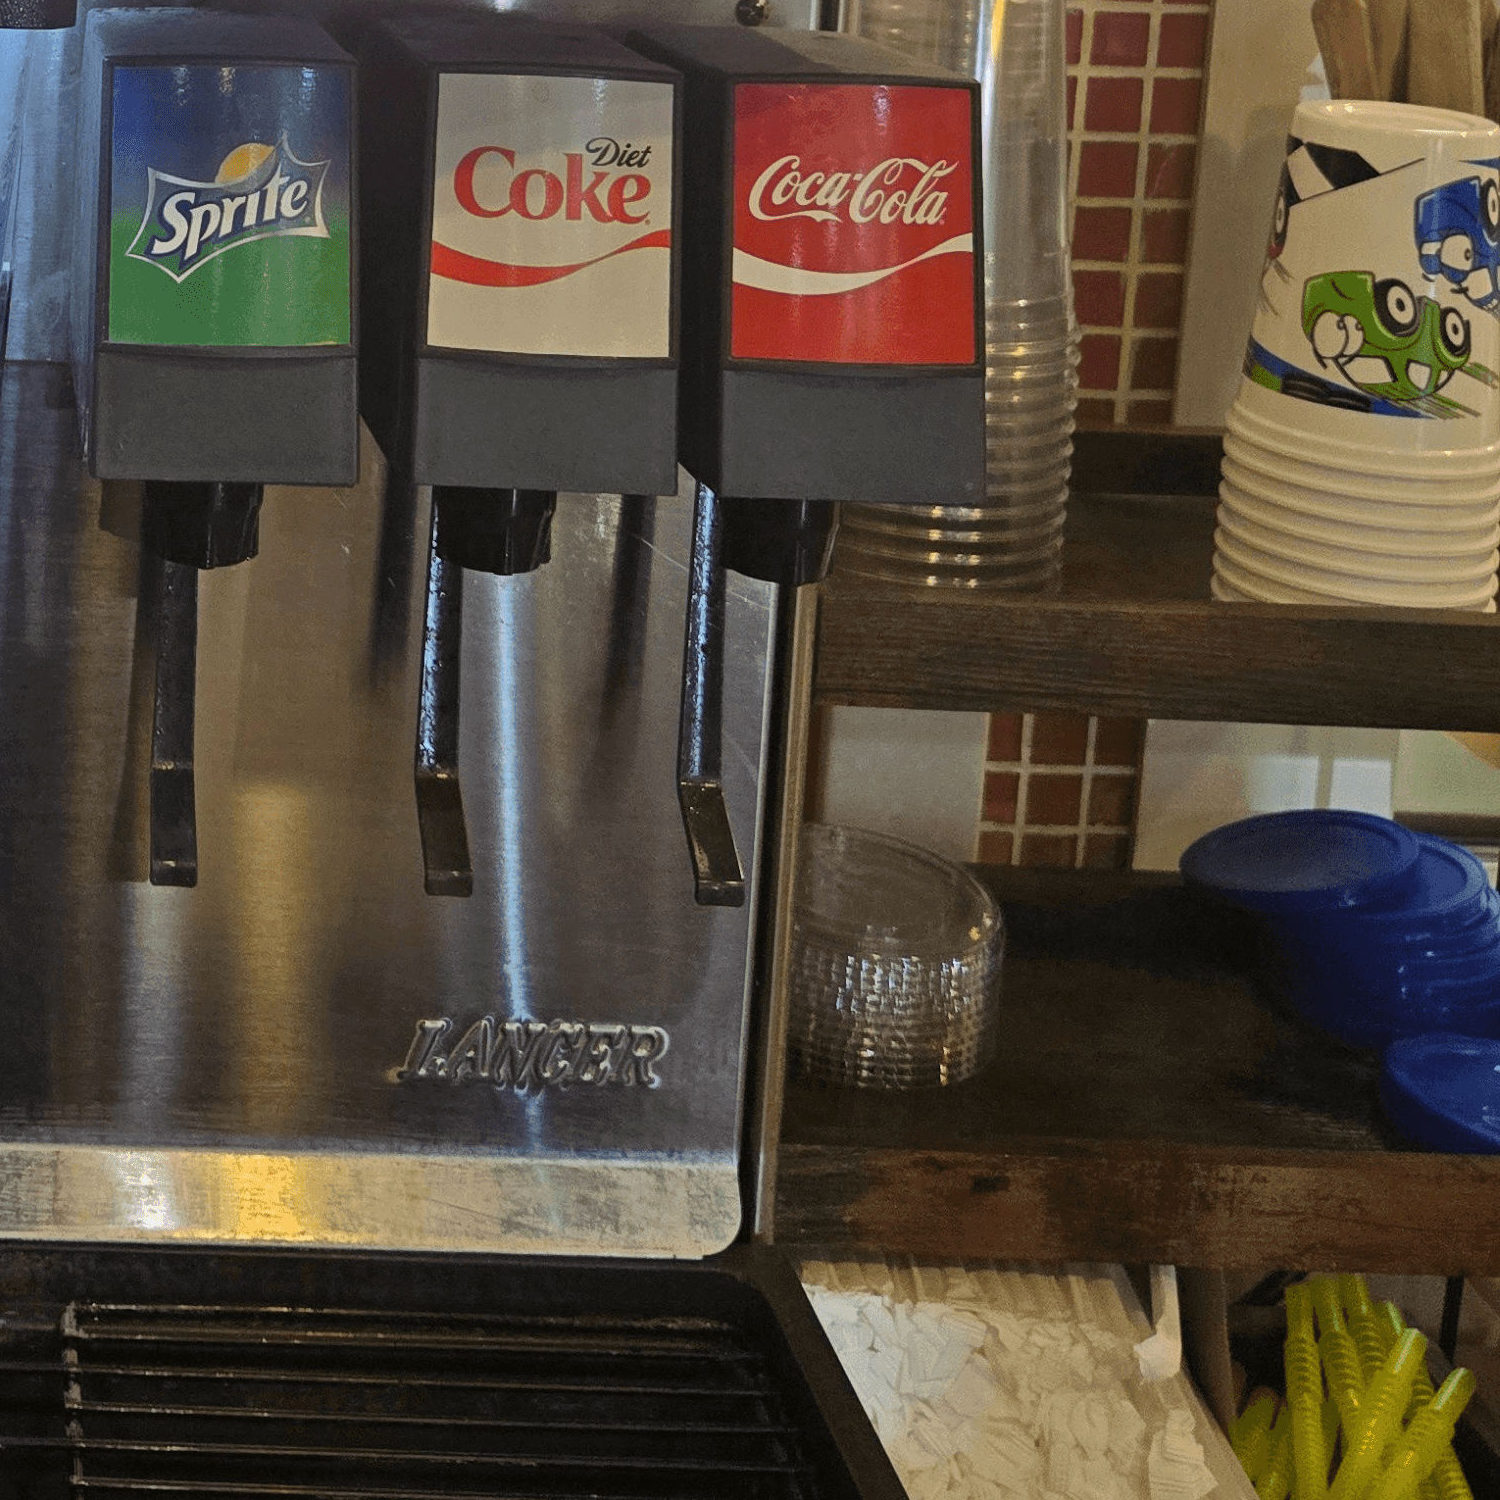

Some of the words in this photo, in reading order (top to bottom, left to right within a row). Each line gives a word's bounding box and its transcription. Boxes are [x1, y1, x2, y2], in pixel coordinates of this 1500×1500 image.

[453, 145, 653, 224] Coke
[585, 137, 652, 168] Diet
[150, 175, 308, 262] Sprite
[748, 155, 958, 225] Coca-Cola
[397, 1017, 670, 1090] LANCER
